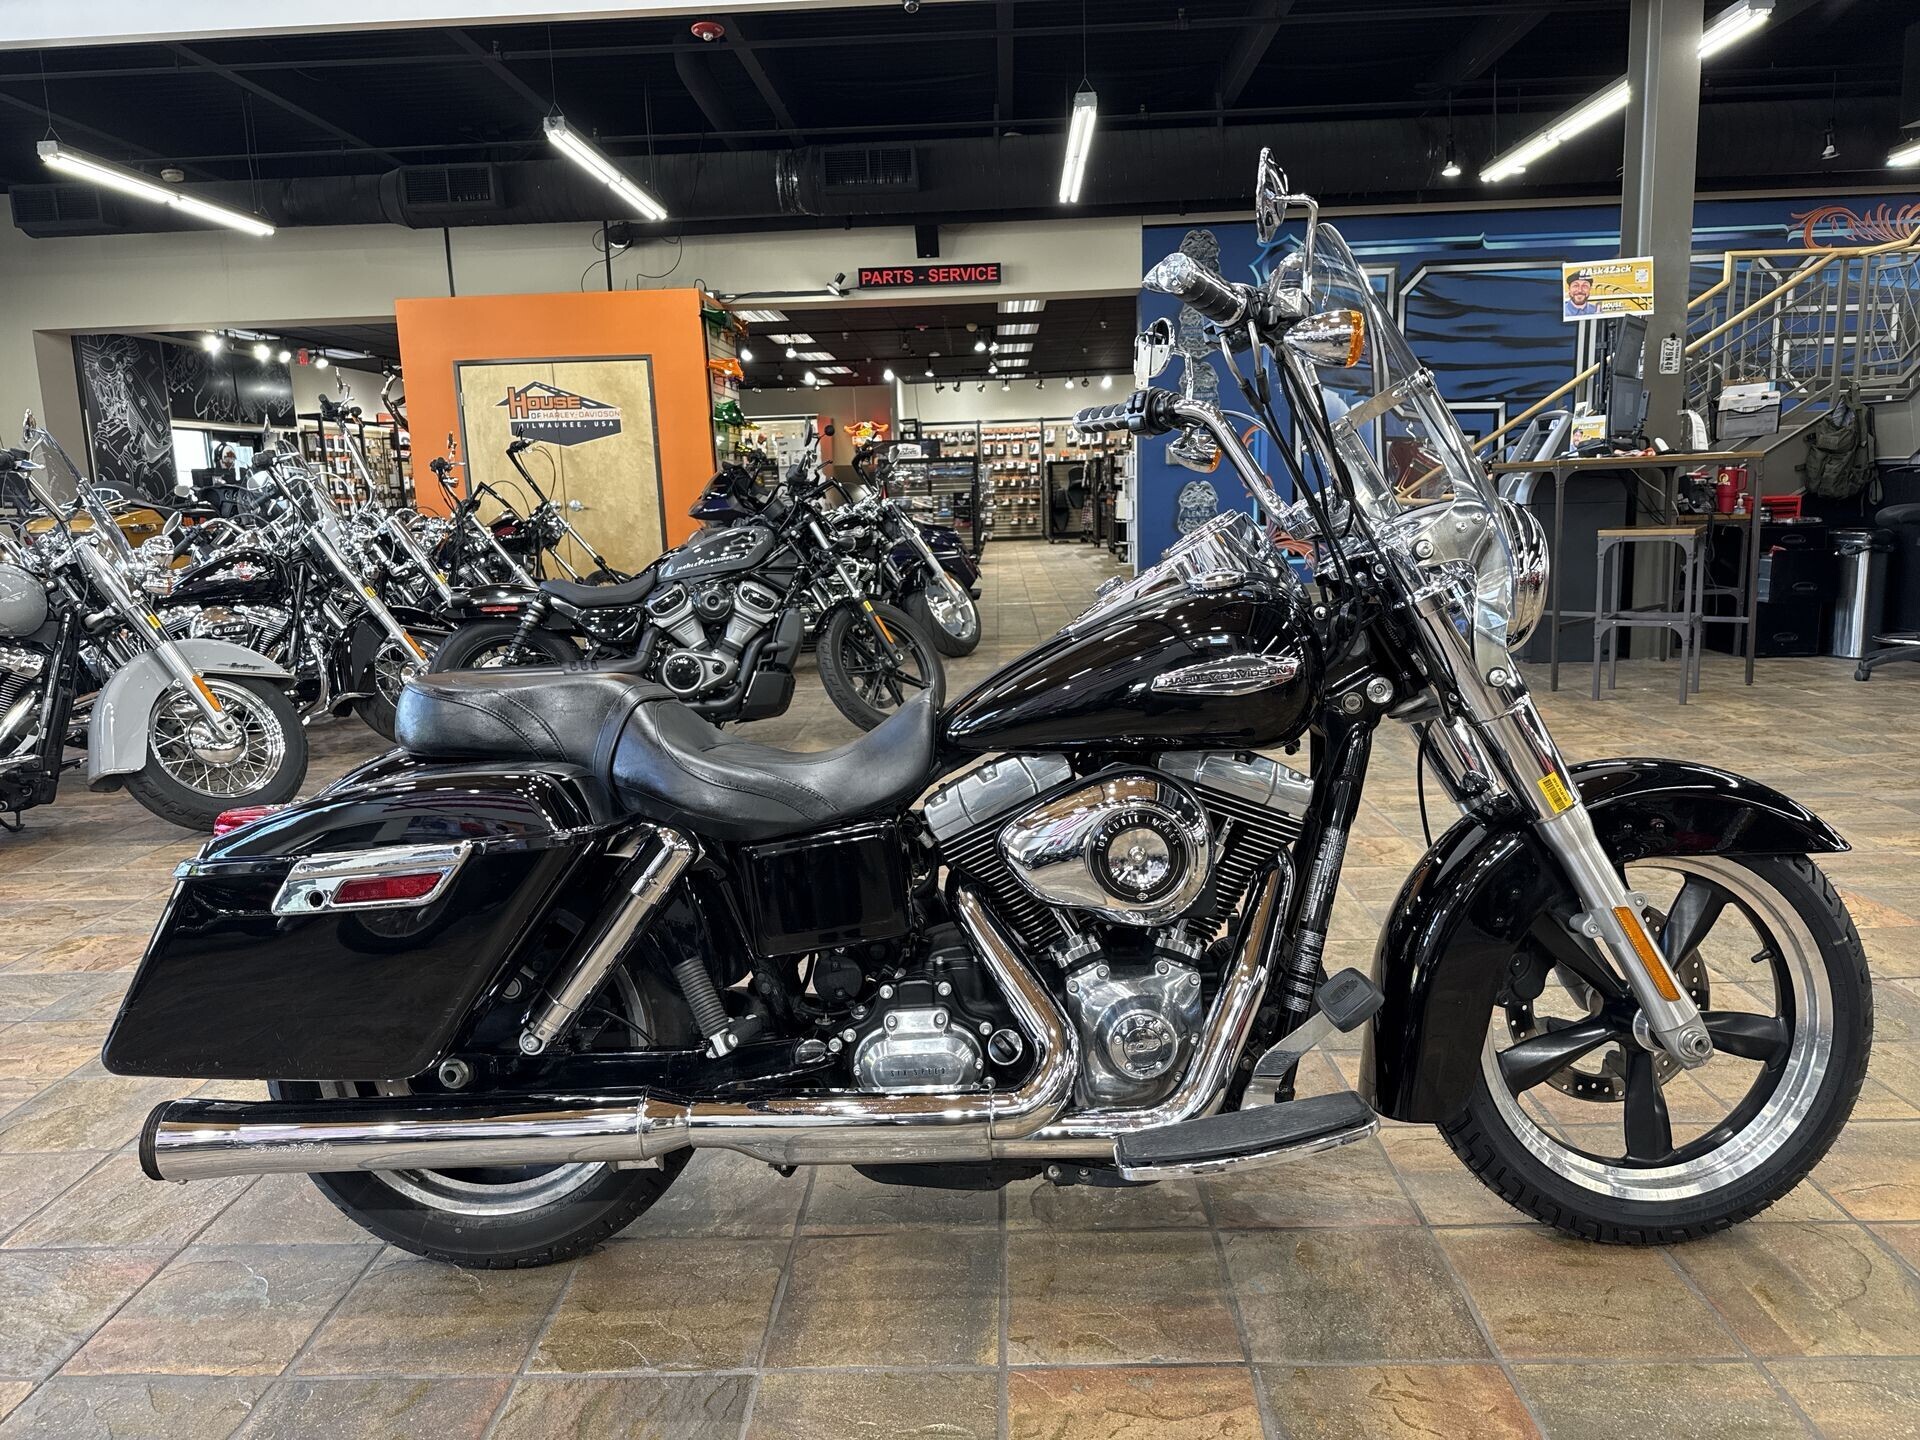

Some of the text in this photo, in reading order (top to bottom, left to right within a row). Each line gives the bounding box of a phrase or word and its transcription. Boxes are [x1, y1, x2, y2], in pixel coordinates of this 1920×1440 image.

[861, 270, 914, 285] PARTS
[928, 266, 998, 282] SERVICE
[1580, 264, 1632, 276] #Ask4Zack
[506, 386, 582, 419] HOUSE
[543, 410, 620, 419] HARLEY-DAVIDSON
[594, 420, 614, 428] USA
[1164, 667, 1286, 685] HARLEY-DAVIDSON
[1097, 815, 1180, 852] 103 CUBIC INCHES
